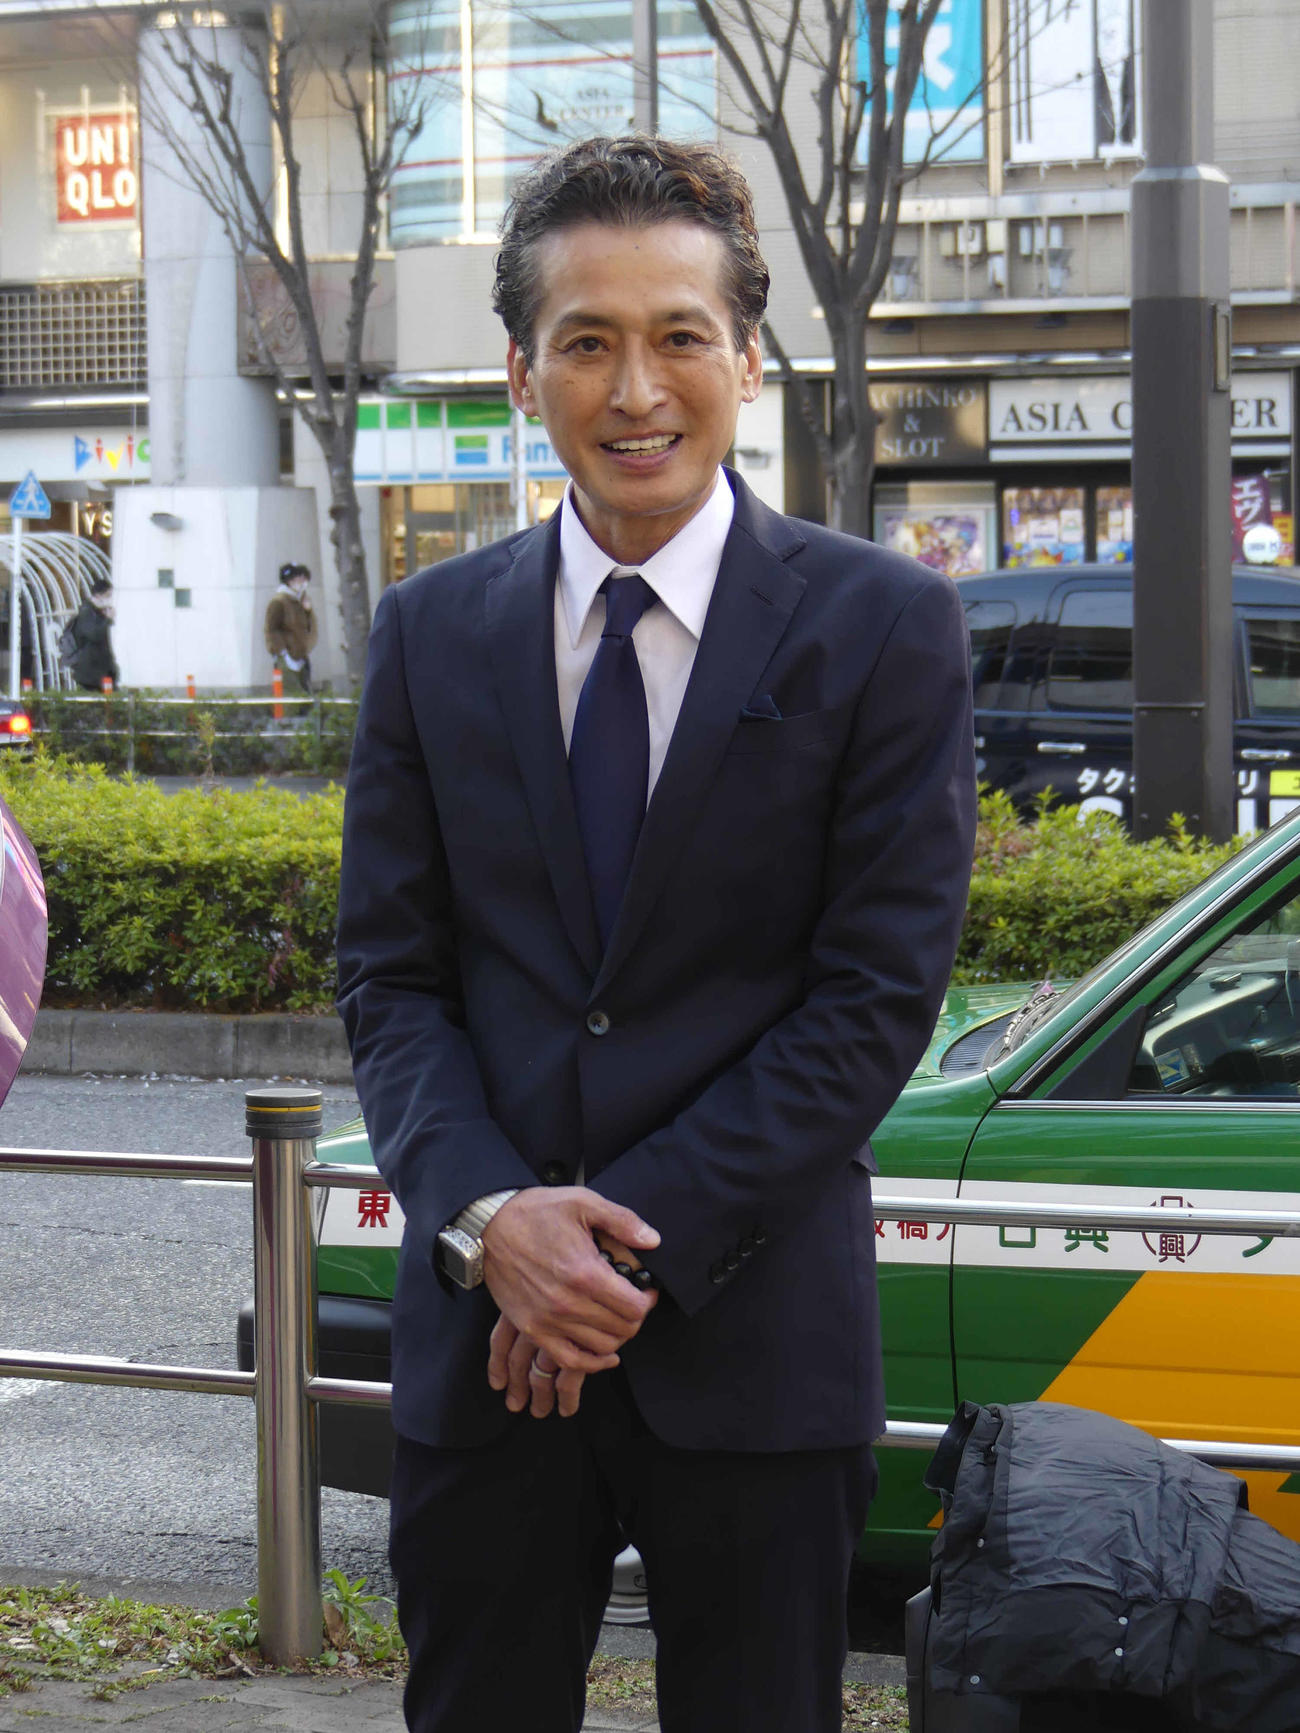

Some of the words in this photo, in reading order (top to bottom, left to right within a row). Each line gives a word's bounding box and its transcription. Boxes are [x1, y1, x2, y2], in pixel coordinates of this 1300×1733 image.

[64, 124, 130, 167] UNI
[66, 168, 137, 217] QLO
[869, 387, 977, 409] ACHINKO
[904, 413, 920, 433] &
[1001, 402, 1090, 432] ASIA
[881, 437, 945, 458] SLOT
